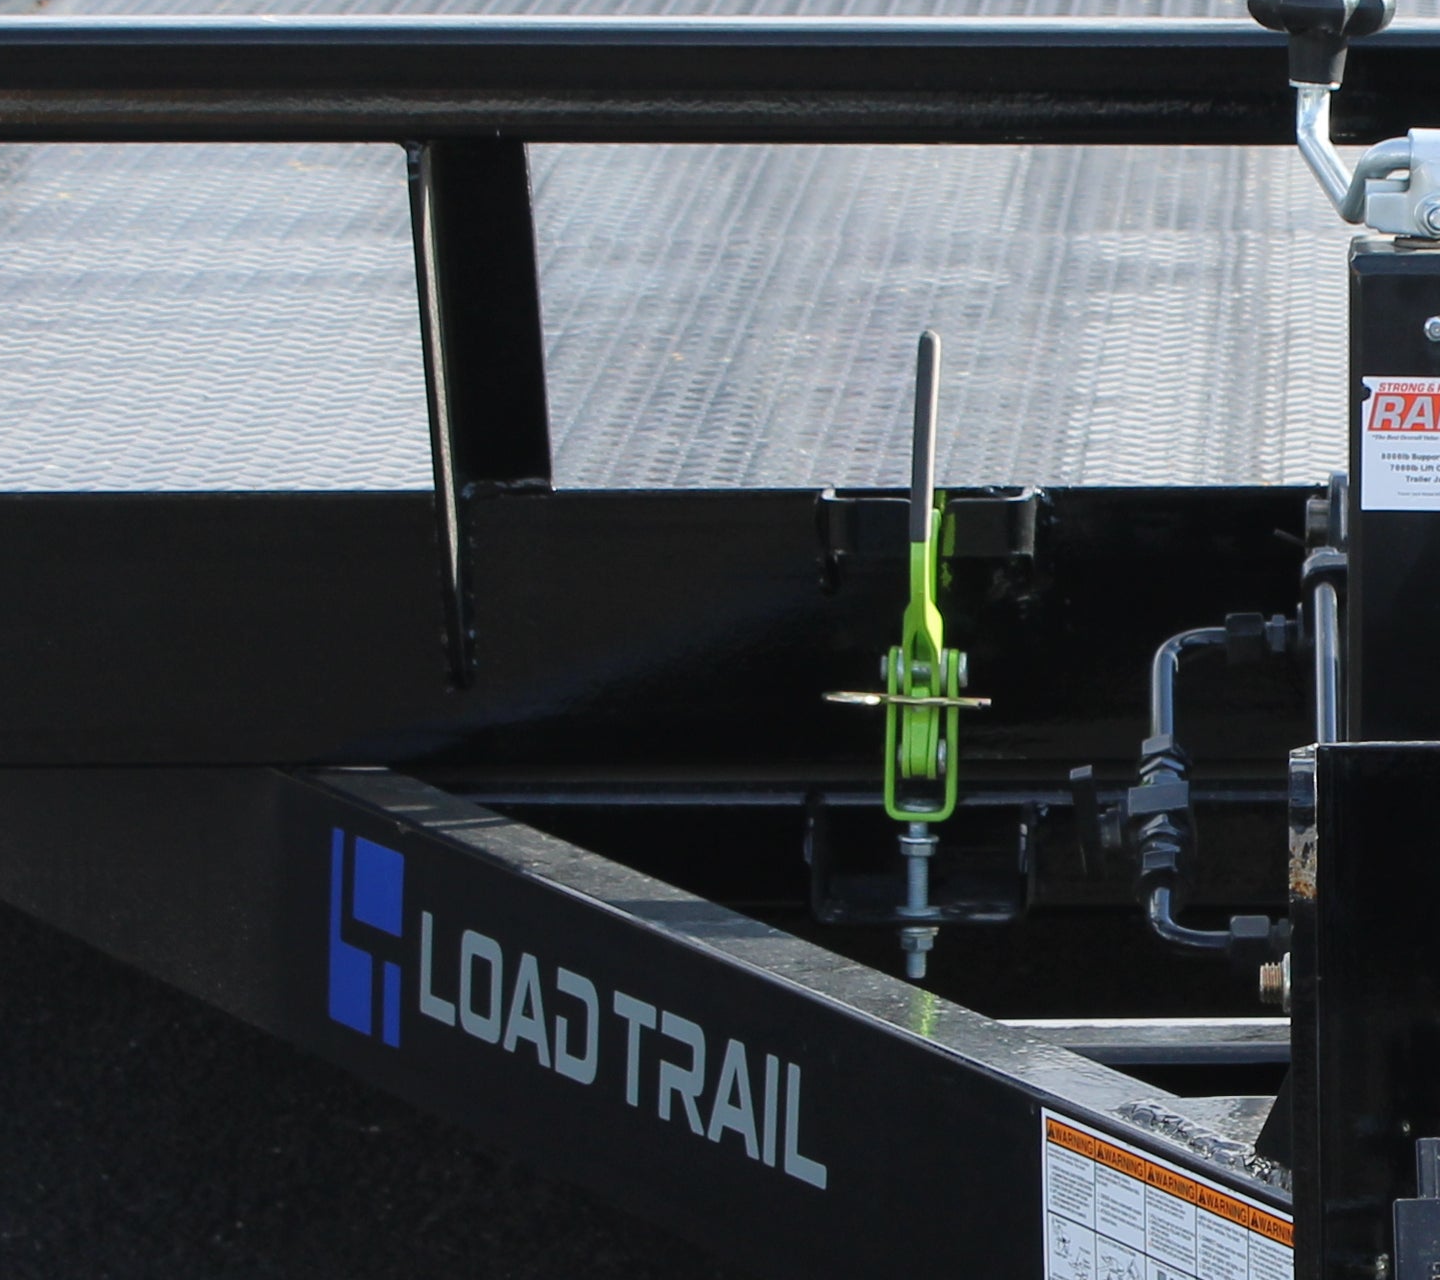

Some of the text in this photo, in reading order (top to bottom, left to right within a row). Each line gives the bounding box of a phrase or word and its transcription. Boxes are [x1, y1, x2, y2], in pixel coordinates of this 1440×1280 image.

[1379, 383, 1426, 392] STRONG
[1427, 383, 1434, 392] &
[1405, 475, 1431, 483] Trailer
[1421, 464, 1434, 472] Lift
[420, 910, 827, 1190] LOAD TRAIL
[1055, 1125, 1093, 1156] WARNING
[1104, 1146, 1143, 1177] WARNING
[1156, 1169, 1195, 1200] WARNING
[1207, 1192, 1247, 1223] WARNING
[1259, 1216, 1293, 1242] WARNIN
